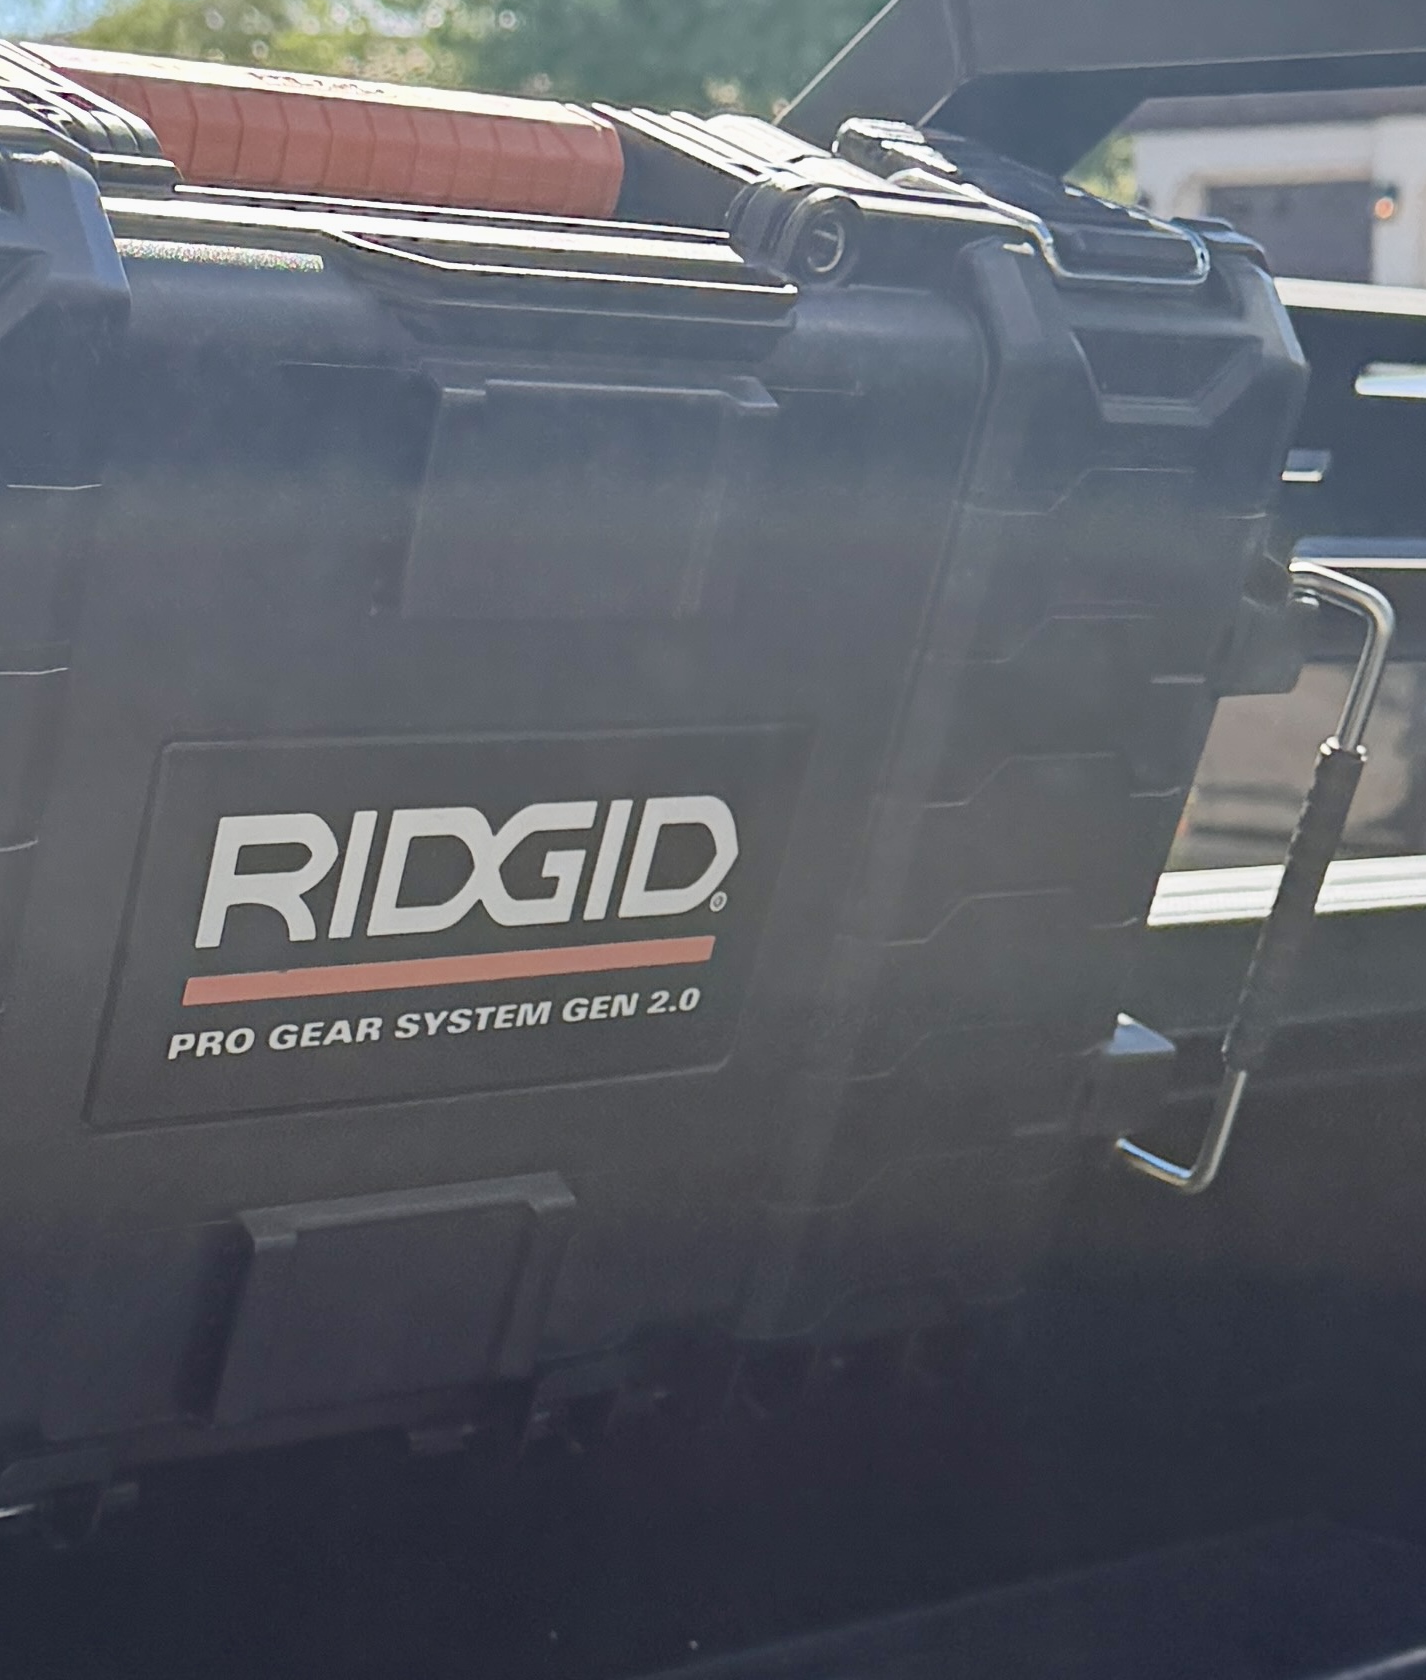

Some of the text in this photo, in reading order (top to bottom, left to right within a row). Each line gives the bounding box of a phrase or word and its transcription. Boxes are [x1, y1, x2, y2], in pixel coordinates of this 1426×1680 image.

[194, 795, 739, 949] RIDGID
[167, 987, 701, 1060] PRO GEAR SYSTEM GEN 2.0
